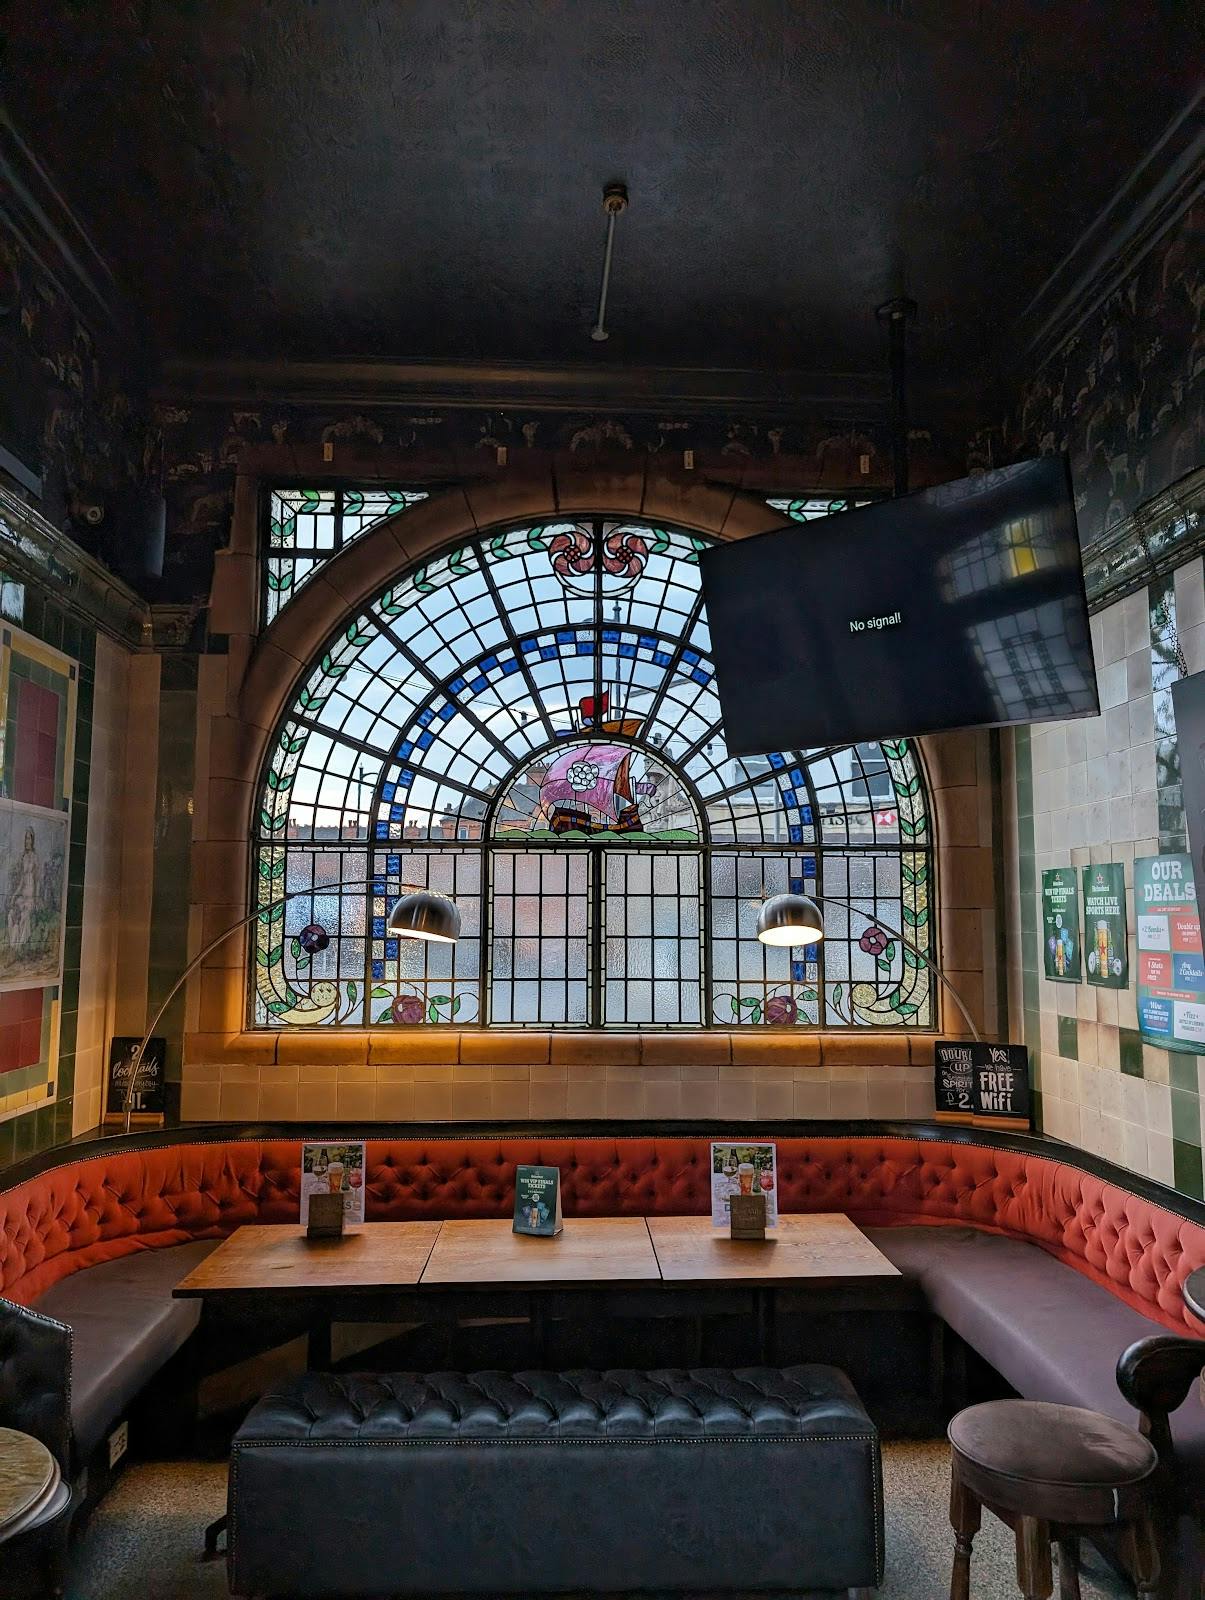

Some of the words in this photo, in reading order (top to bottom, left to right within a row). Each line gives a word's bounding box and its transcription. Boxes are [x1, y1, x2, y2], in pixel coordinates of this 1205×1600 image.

[850, 620, 865, 632] No
[867, 612, 901, 629] signal!
[1152, 861, 1182, 880] OUR
[1144, 882, 1196, 902] DEALS
[1087, 897, 1104, 906] WATCH
[1104, 896, 1118, 905] LIVE
[1085, 906, 1104, 915] SPORTS
[1105, 905, 1121, 915] HERE
[131, 1045, 140, 1060] 2
[940, 1048, 973, 1061] DOUBL
[995, 1064, 1011, 1072] have
[942, 1079, 973, 1089] SPIRIT
[980, 1071, 1014, 1092] FREE
